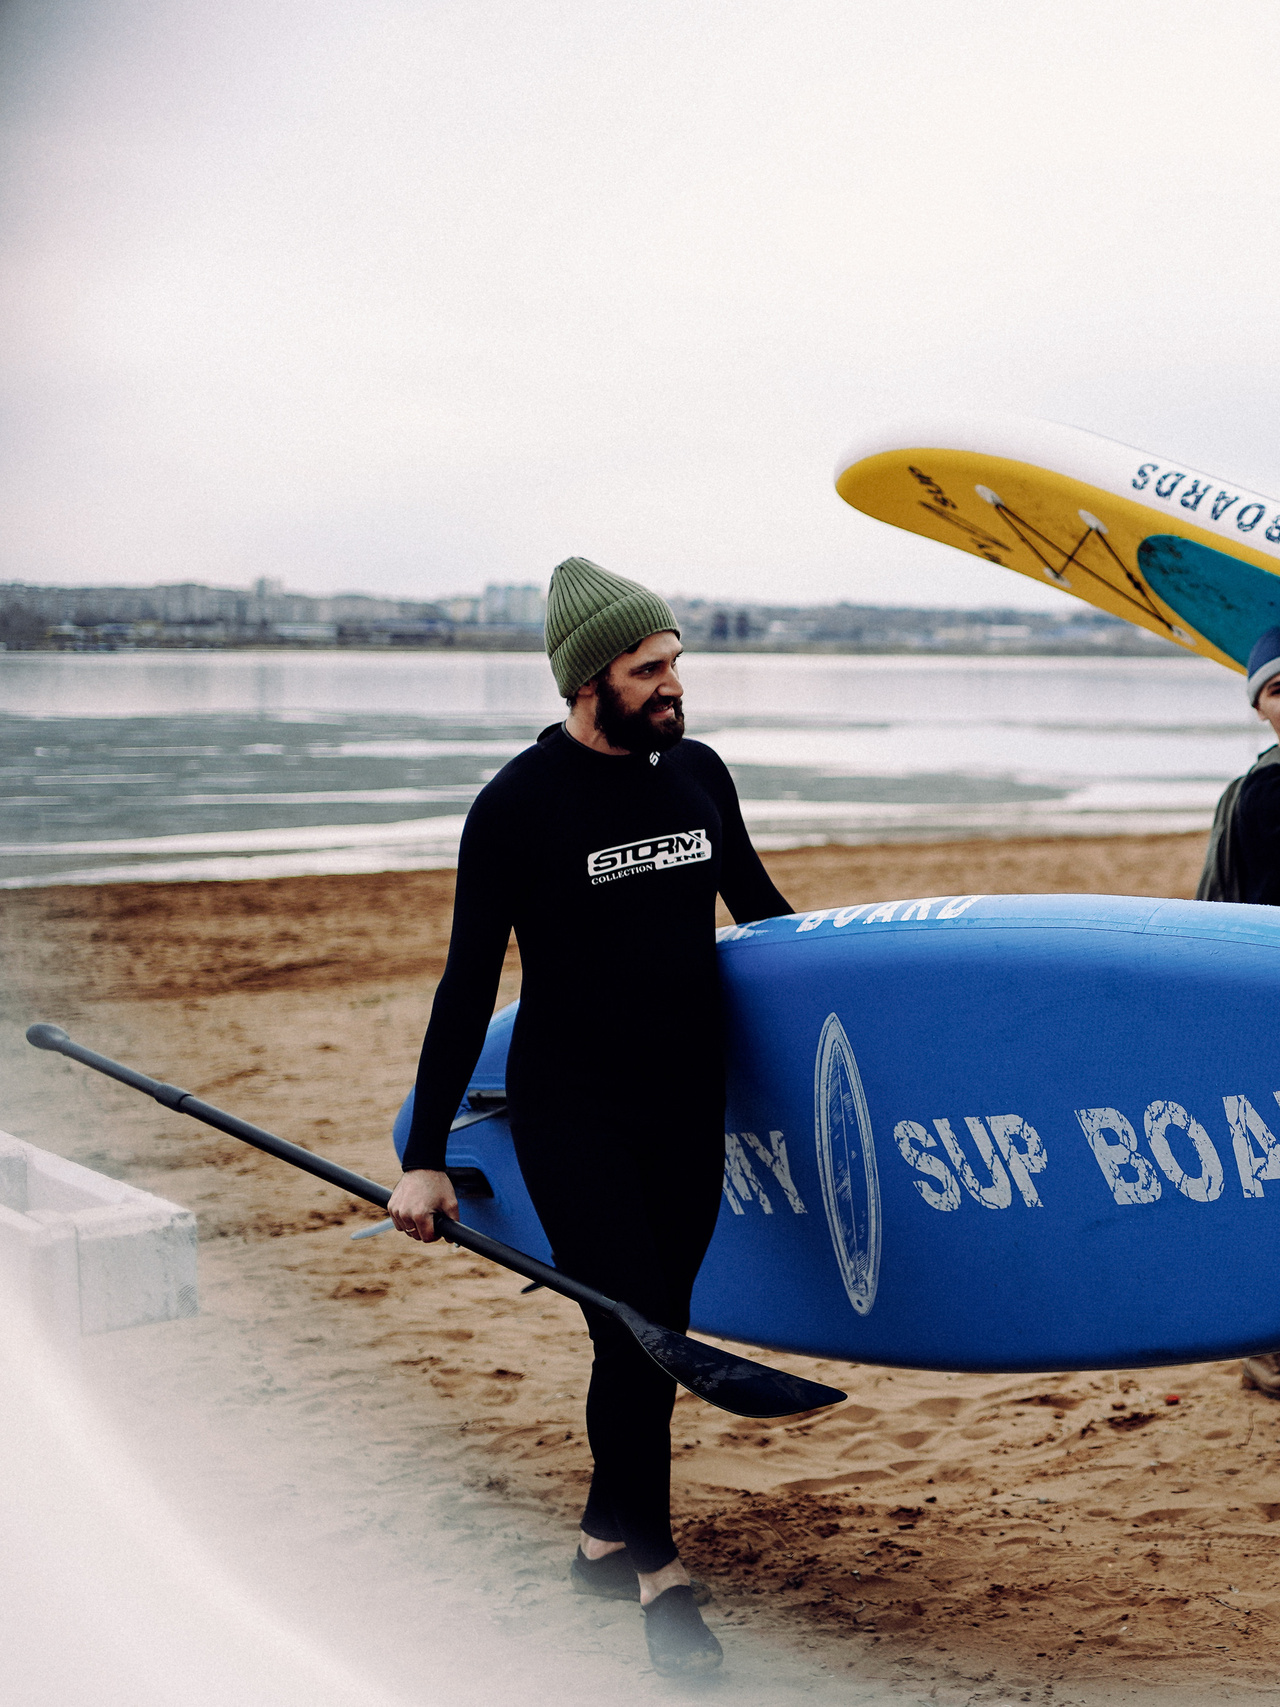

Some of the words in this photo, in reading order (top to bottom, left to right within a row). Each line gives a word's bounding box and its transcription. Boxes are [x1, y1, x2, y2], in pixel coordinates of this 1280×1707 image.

[592, 830, 703, 872] STORM
[662, 851, 706, 865] LINE
[591, 864, 653, 885] COLLECTION
[893, 1114, 1047, 1211] SUP
